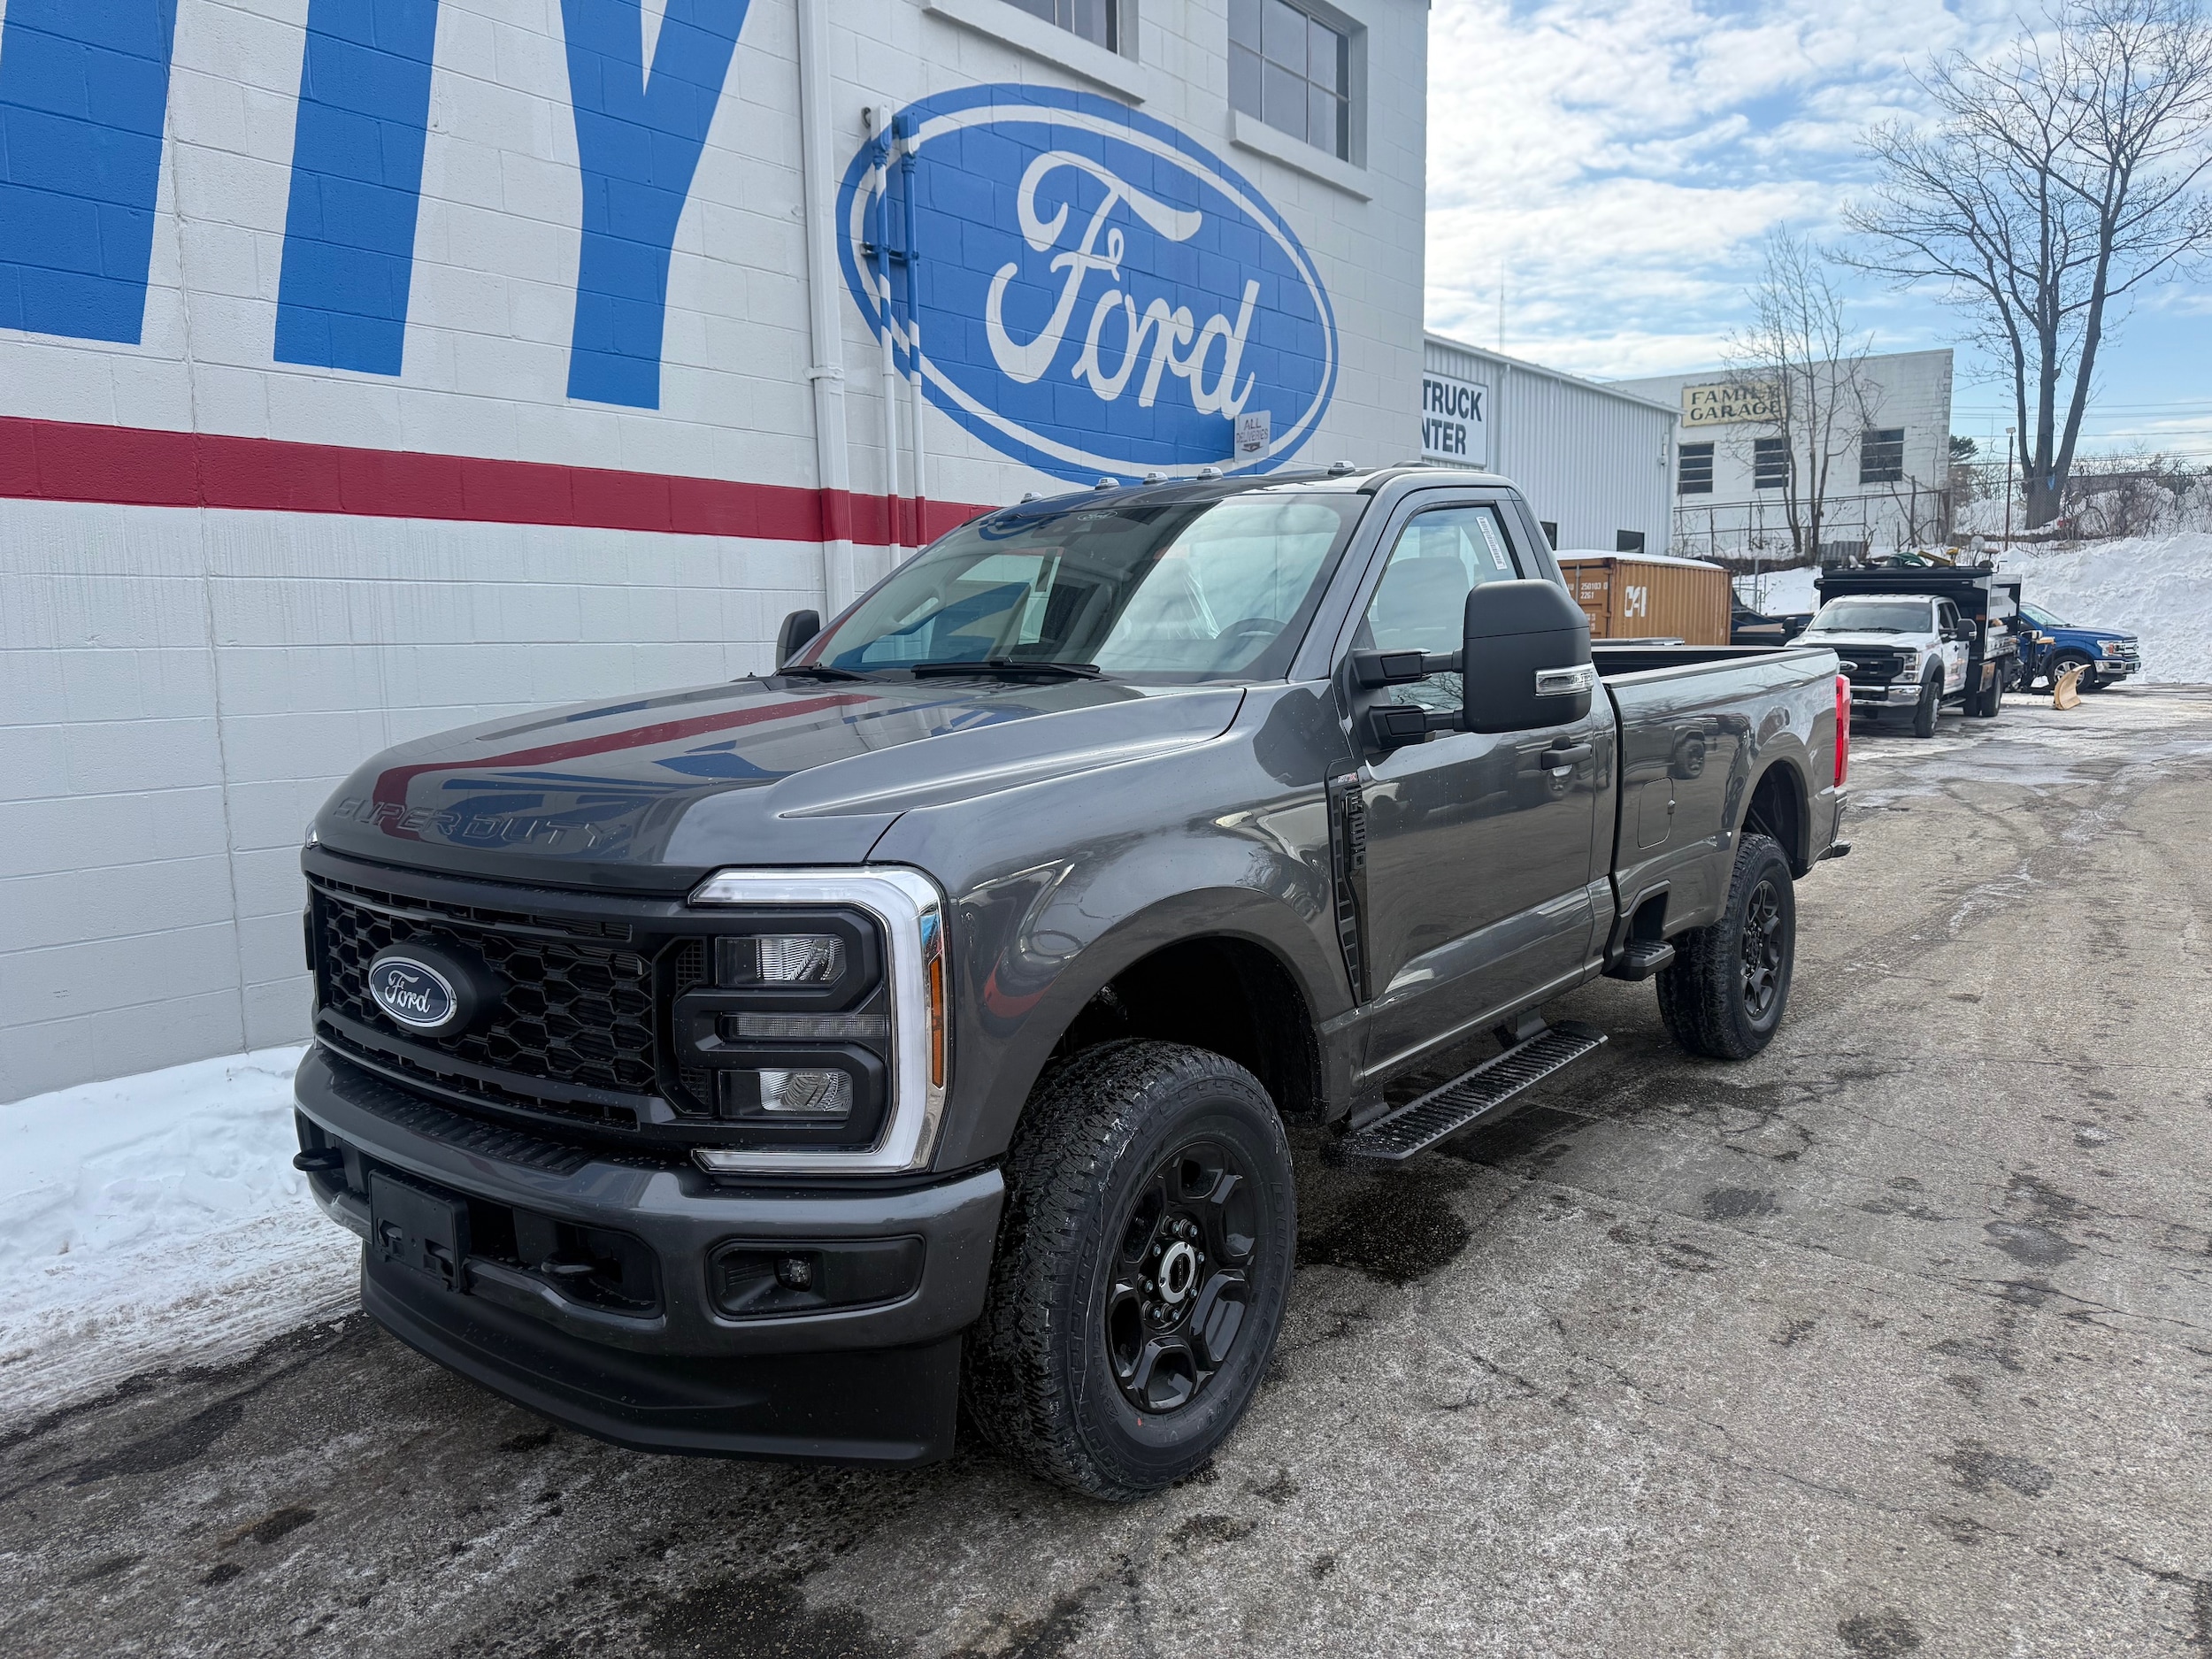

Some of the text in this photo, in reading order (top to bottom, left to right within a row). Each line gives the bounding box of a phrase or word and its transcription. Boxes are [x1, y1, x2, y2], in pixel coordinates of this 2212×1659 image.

[987, 150, 1261, 420] Ford
[1423, 379, 1482, 422] TRUCK
[1691, 401, 1781, 420] GARAGE
[1236, 428, 1268, 443] DELIVERIES
[1243, 418, 1262, 431] ALL
[1624, 586, 1647, 617] CAI
[334, 798, 626, 848] SUPER DUTY
[384, 970, 431, 1013] Ford
